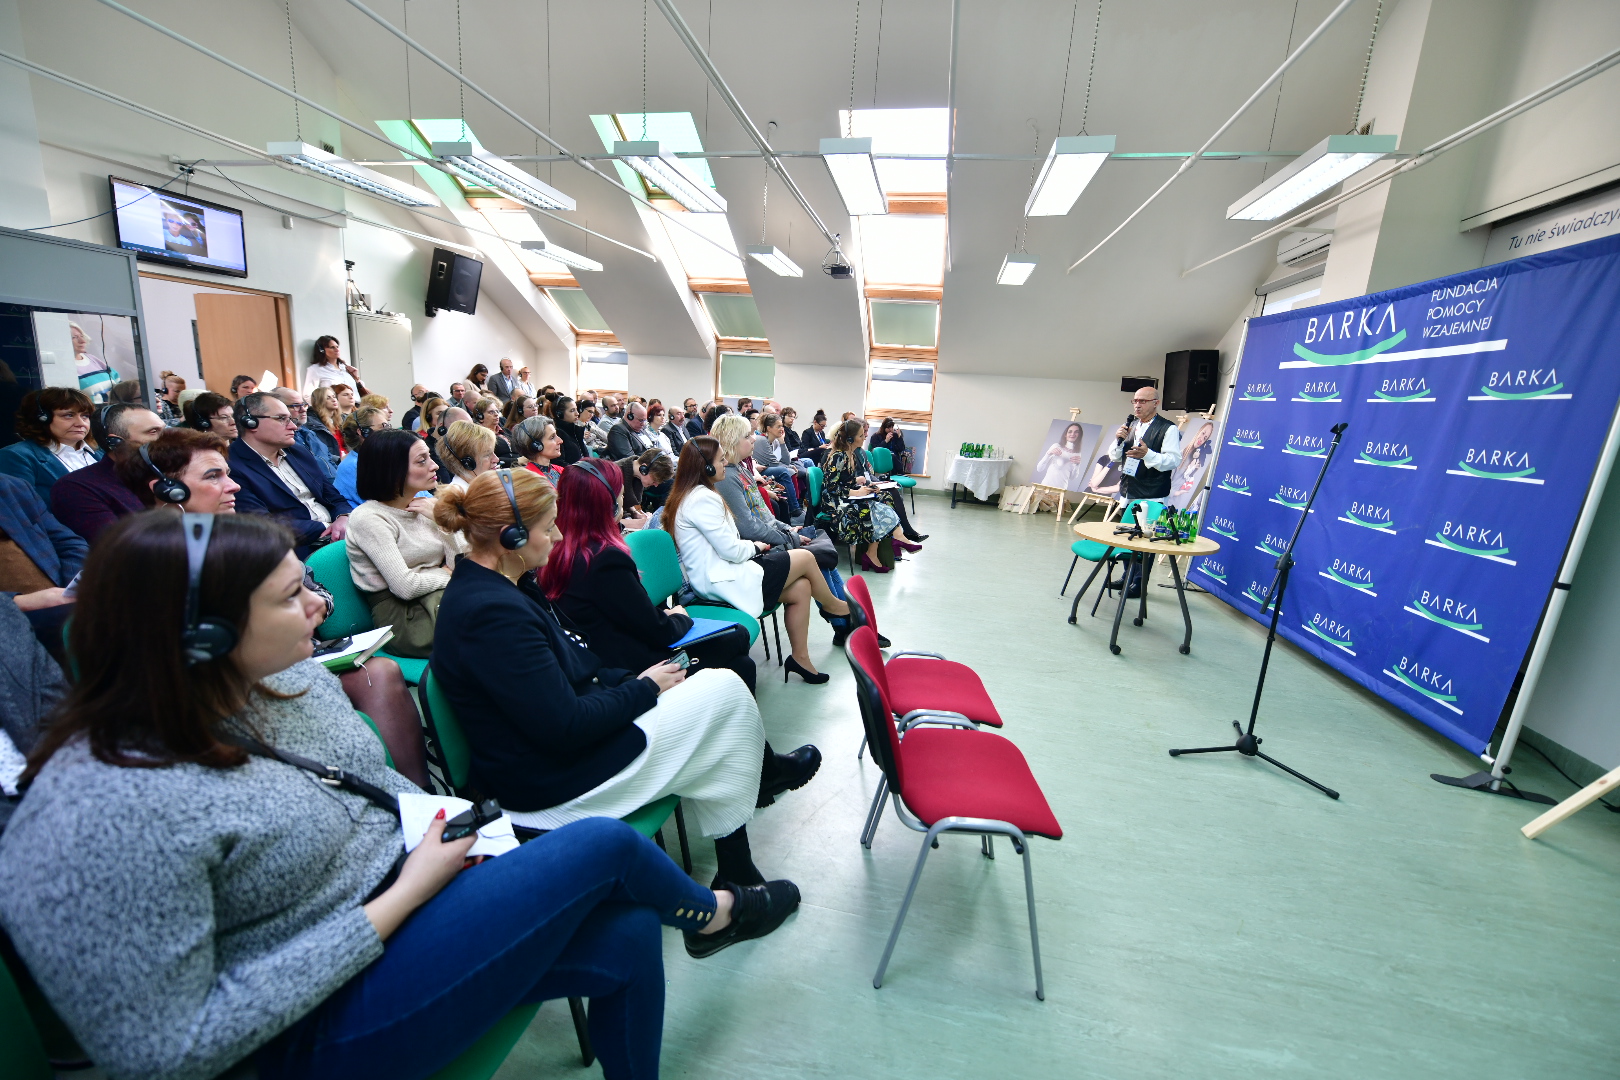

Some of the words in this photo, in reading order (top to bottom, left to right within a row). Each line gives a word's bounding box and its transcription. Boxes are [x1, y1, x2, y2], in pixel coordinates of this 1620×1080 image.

[1508, 235, 1523, 251] Tu
[1524, 229, 1546, 246] nie
[1430, 276, 1498, 303] FUNDACJA
[1426, 298, 1486, 321] POMOCY
[1304, 302, 1397, 344] BARKA
[1422, 315, 1493, 339] WZAJEMNEJ
[1246, 383, 1273, 393] BARKA
[1303, 381, 1337, 393] BARKA
[1381, 377, 1426, 392] BARKA
[1488, 368, 1557, 387] BARKA
[1235, 428, 1261, 441] BARKA
[1288, 434, 1324, 449] BARKA
[1365, 441, 1409, 458] BARKA
[1465, 448, 1529, 469] BARKA
[1225, 472, 1248, 487] BARKA
[1279, 485, 1307, 502] BARKA
[1350, 501, 1390, 522] BARKA
[1214, 516, 1235, 532] BARKA
[1442, 520, 1504, 548] BARKA
[1203, 557, 1225, 575] BARKA
[1332, 558, 1371, 583] BARKA
[1250, 580, 1278, 601] BAR
[1420, 590, 1477, 624] BARKA
[1312, 612, 1350, 641] BARKA
[1399, 656, 1452, 695] BARKA
